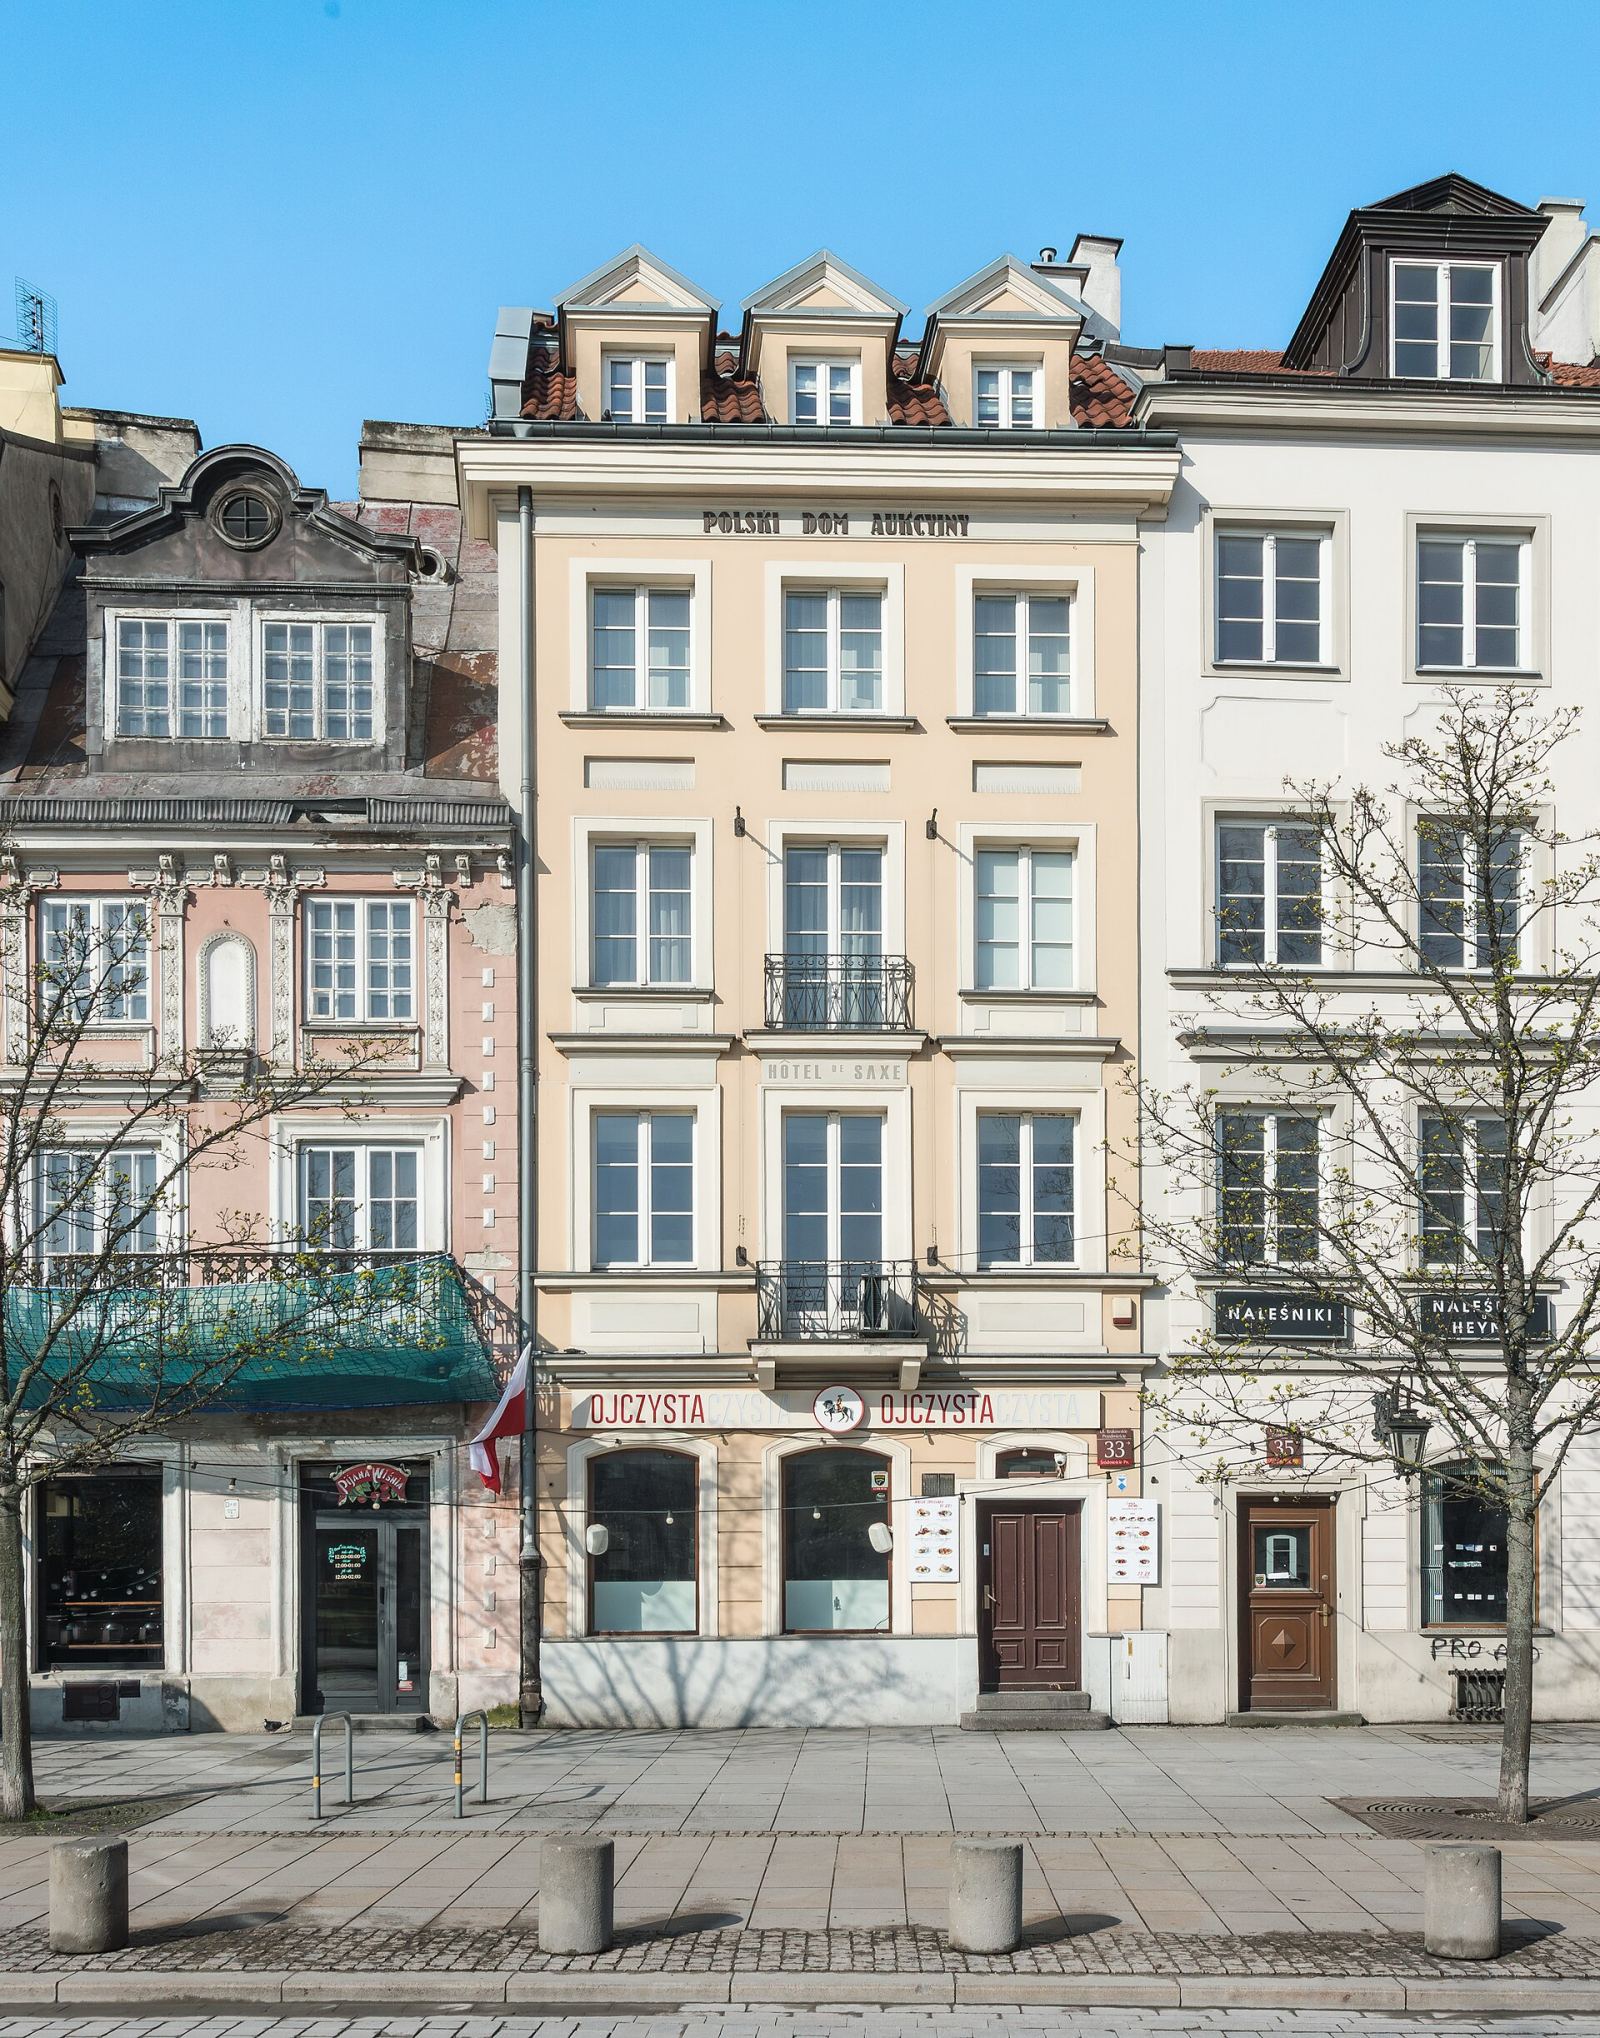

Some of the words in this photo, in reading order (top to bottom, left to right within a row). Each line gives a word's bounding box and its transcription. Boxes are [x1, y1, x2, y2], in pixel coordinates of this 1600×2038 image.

[703, 510, 780, 534] POLSKI
[802, 512, 849, 535] DOM
[871, 511, 970, 537] AUKCYJNY
[768, 1059, 822, 1080] HÔTEL
[854, 1065, 901, 1080] SAXE
[1228, 1305, 1332, 1321] NALEŚNIKI
[591, 1394, 705, 1424] OJCZYSTA
[881, 1394, 994, 1424] OJCZYSTA
[1104, 1440, 1125, 1458] 33
[1274, 1440, 1294, 1457] 35
